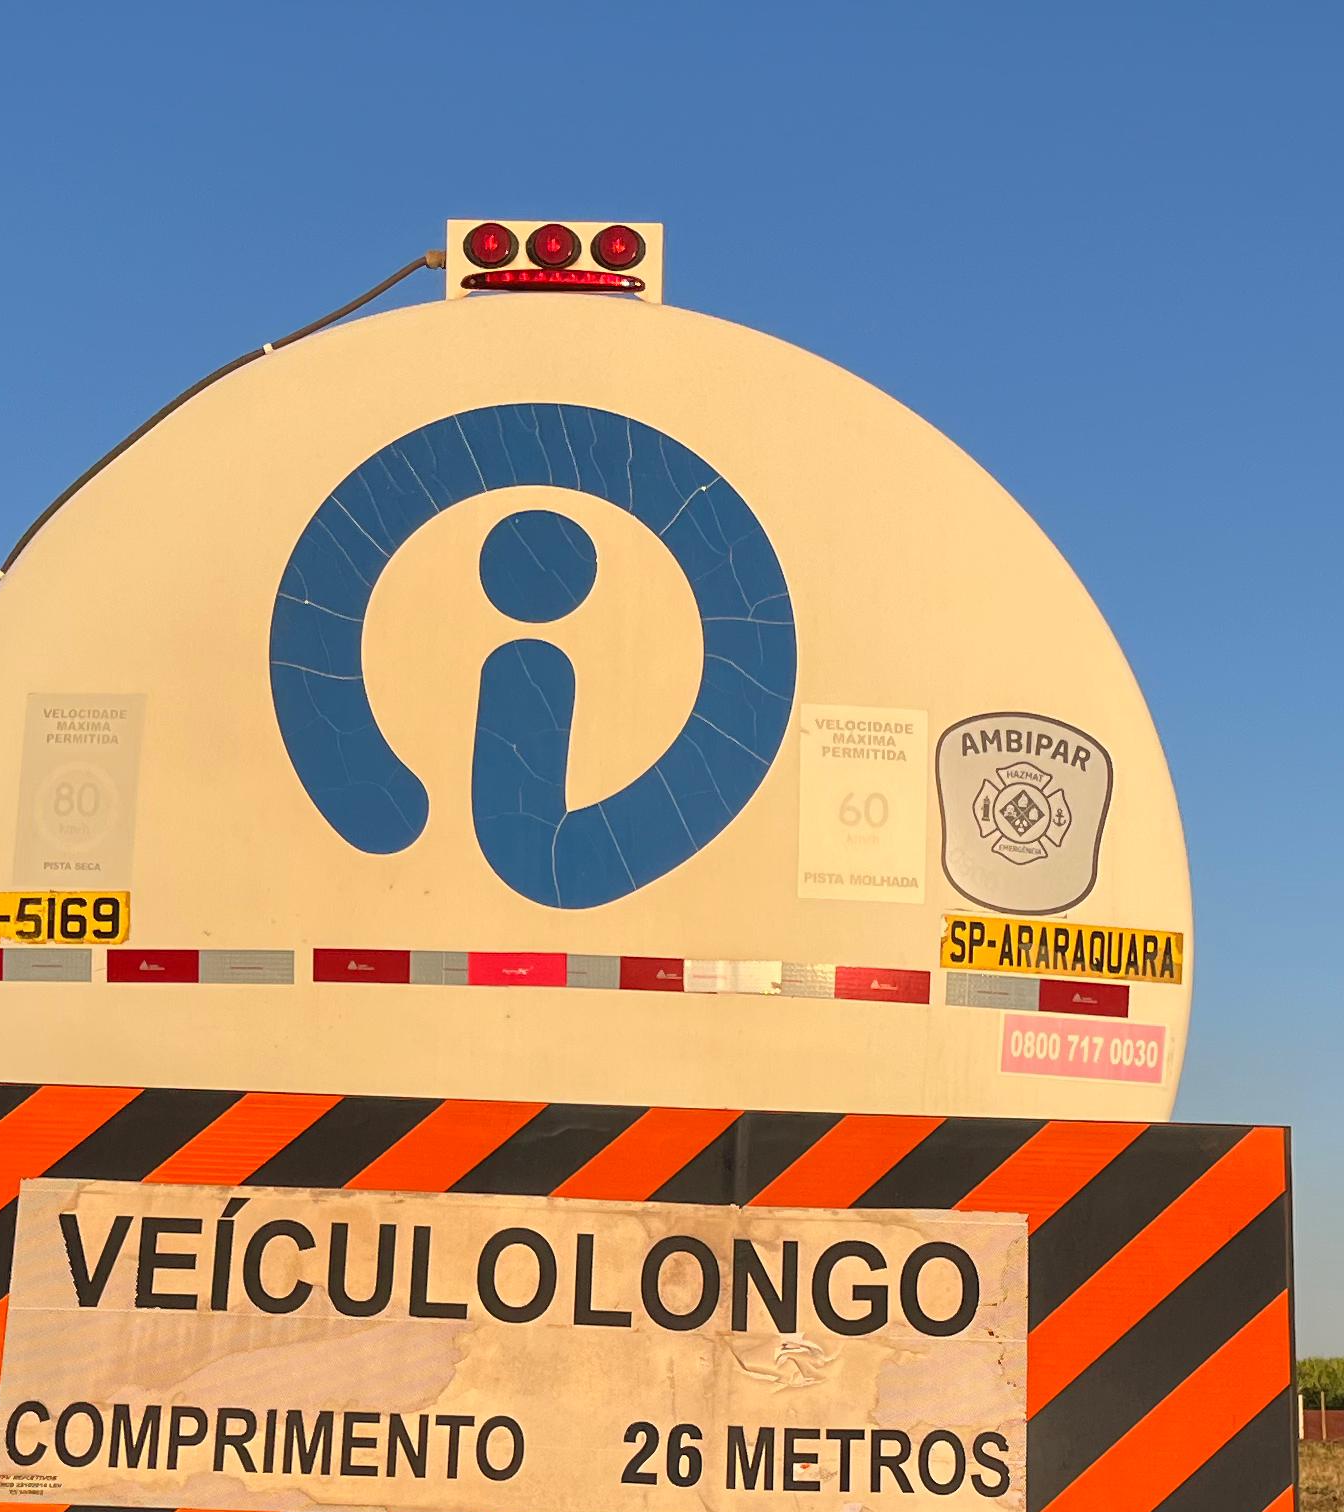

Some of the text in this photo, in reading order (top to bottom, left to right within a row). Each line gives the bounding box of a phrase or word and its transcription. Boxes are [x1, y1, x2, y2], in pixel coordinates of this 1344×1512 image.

[43, 708, 128, 719] VELOCIDADE
[814, 718, 914, 735] VELOCIDADE
[46, 733, 119, 744] PERMITIDA
[821, 746, 908, 761] PERMITIDA
[961, 729, 1091, 772] AMBIPAR
[1006, 770, 1043, 783] HAZMAT
[54, 782, 100, 817] 80
[839, 792, 889, 828] 60
[43, 862, 71, 871] PISTA
[804, 871, 920, 888] PISTA MOLHADA
[950, 920, 1175, 978] SP-ARARAQUARA
[1011, 1030, 1158, 1069] 0800 717 0030
[5, 1400, 1011, 1498] COMPRIMENTO 26 METROS
